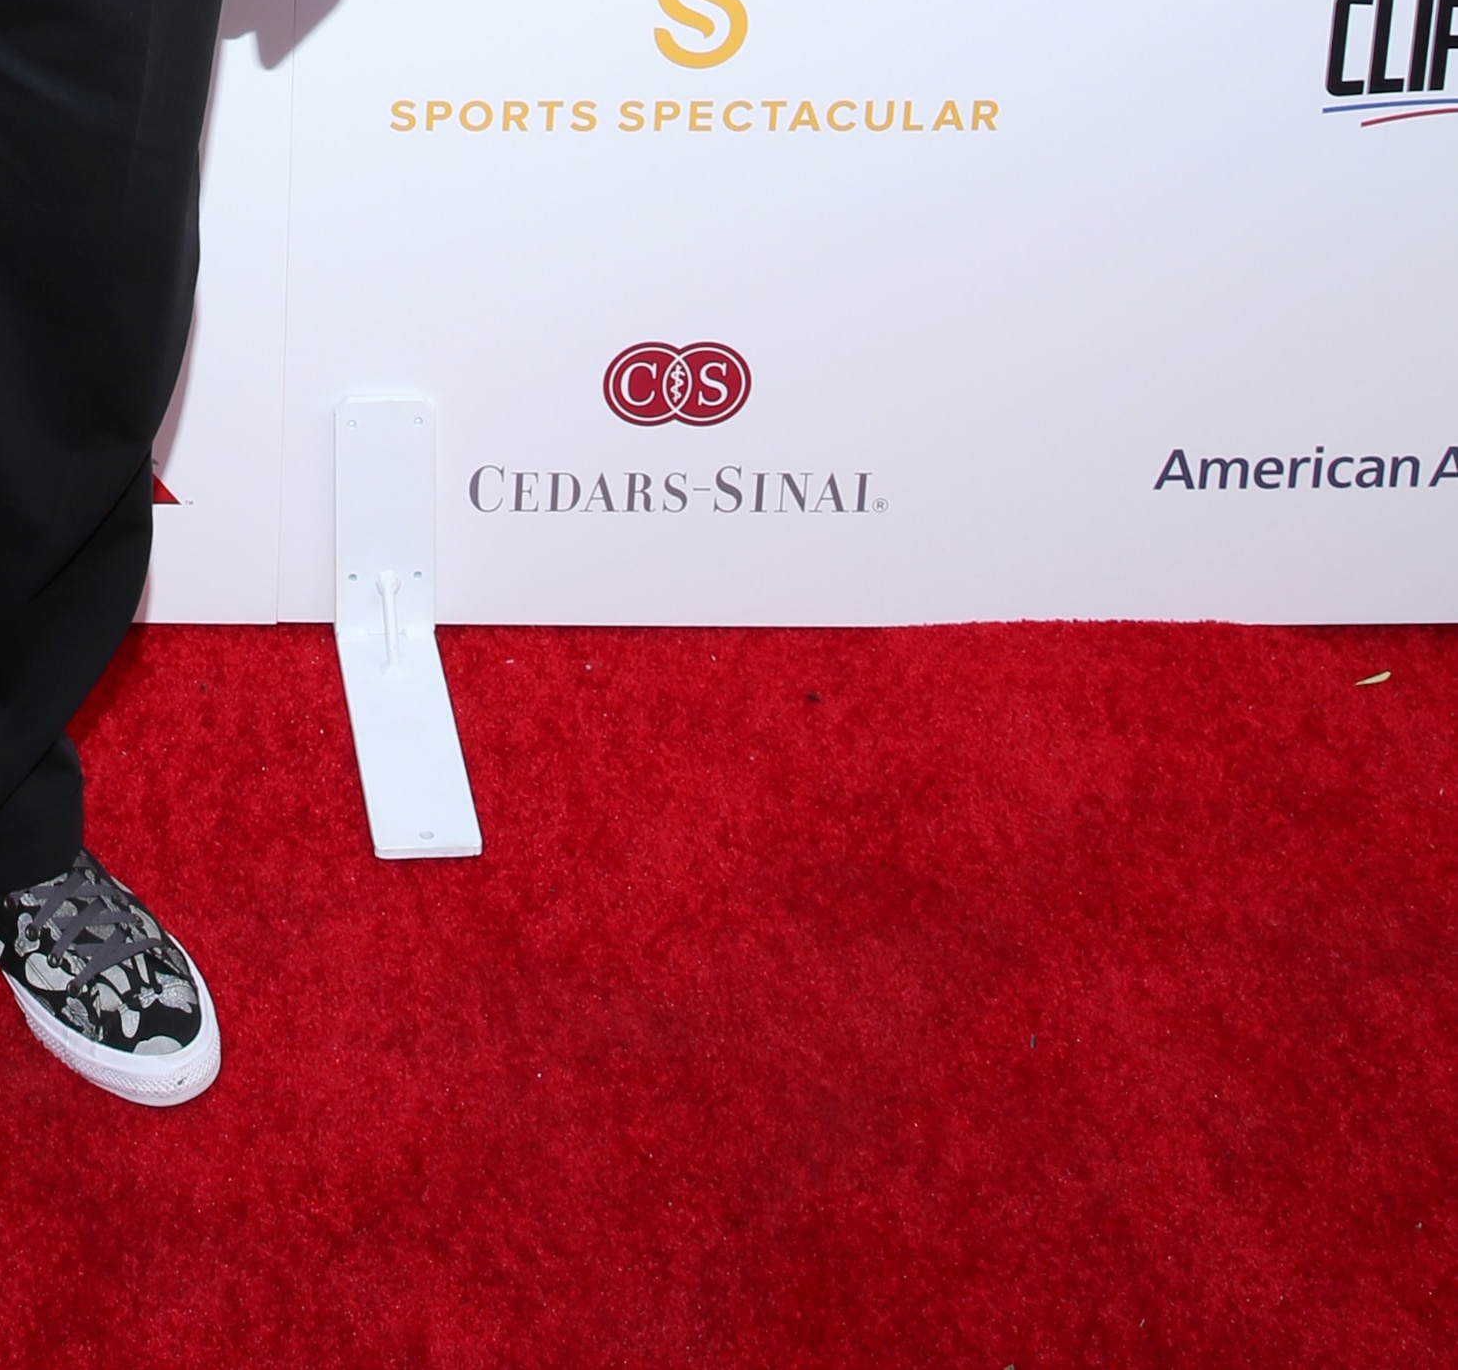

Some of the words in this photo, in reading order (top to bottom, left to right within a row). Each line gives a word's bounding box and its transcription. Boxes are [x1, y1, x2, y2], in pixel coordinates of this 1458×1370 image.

[390, 99, 597, 133] SPORTS
[618, 99, 999, 133] SPECTACULAR
[1153, 445, 1421, 490] American
